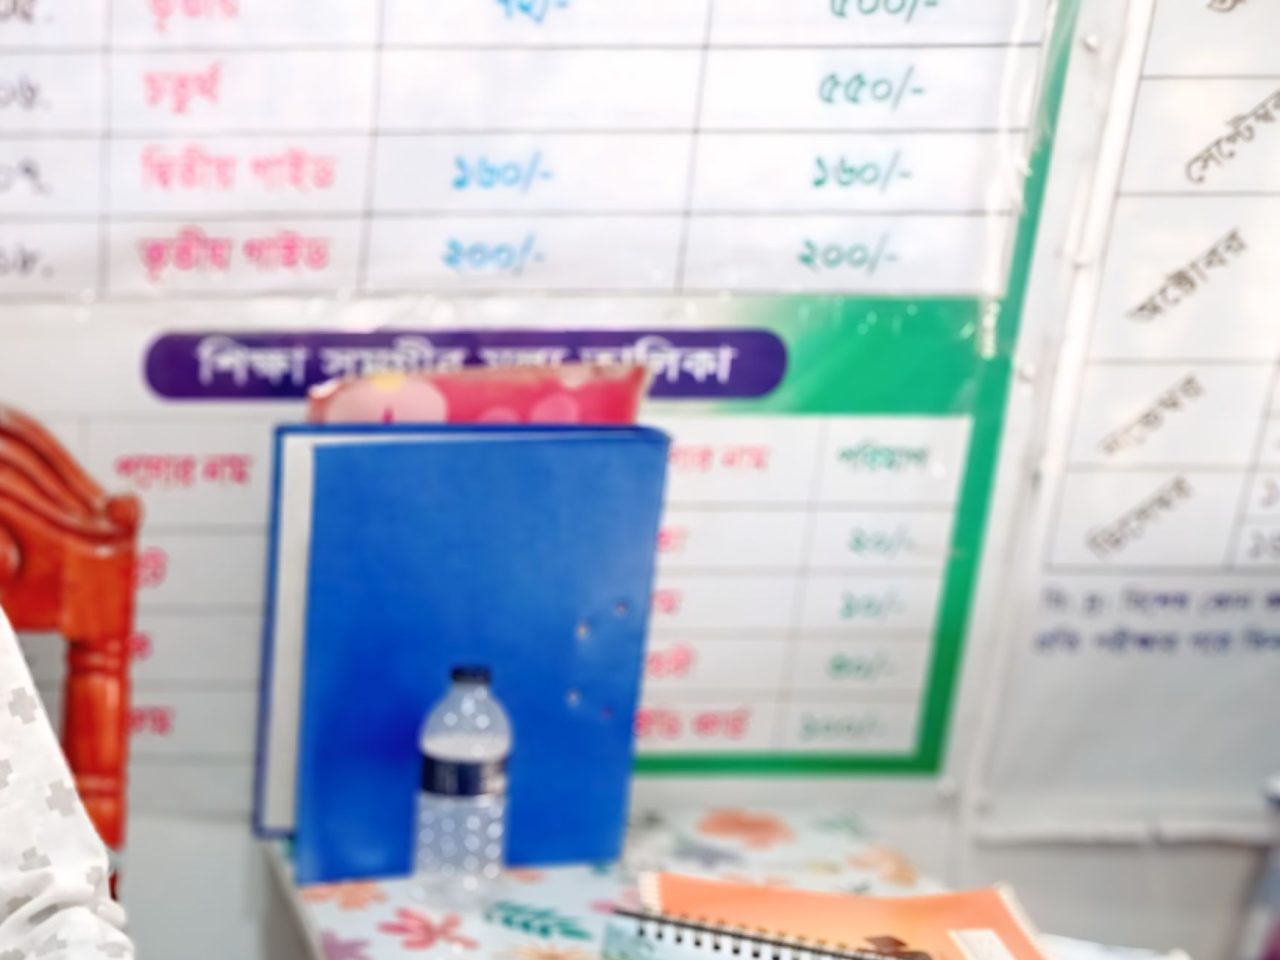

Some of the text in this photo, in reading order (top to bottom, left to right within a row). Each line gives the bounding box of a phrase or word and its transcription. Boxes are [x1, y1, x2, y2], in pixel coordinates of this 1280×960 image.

[819, 65, 926, 110] ৫৫০/-
[452, 151, 554, 192] ১৬০/-
[813, 149, 912, 192] ১৬০/-
[442, 233, 546, 275] ২০০/-
[798, 233, 898, 275] ২০০/-
[196, 336, 304, 384] শিক্ষা
